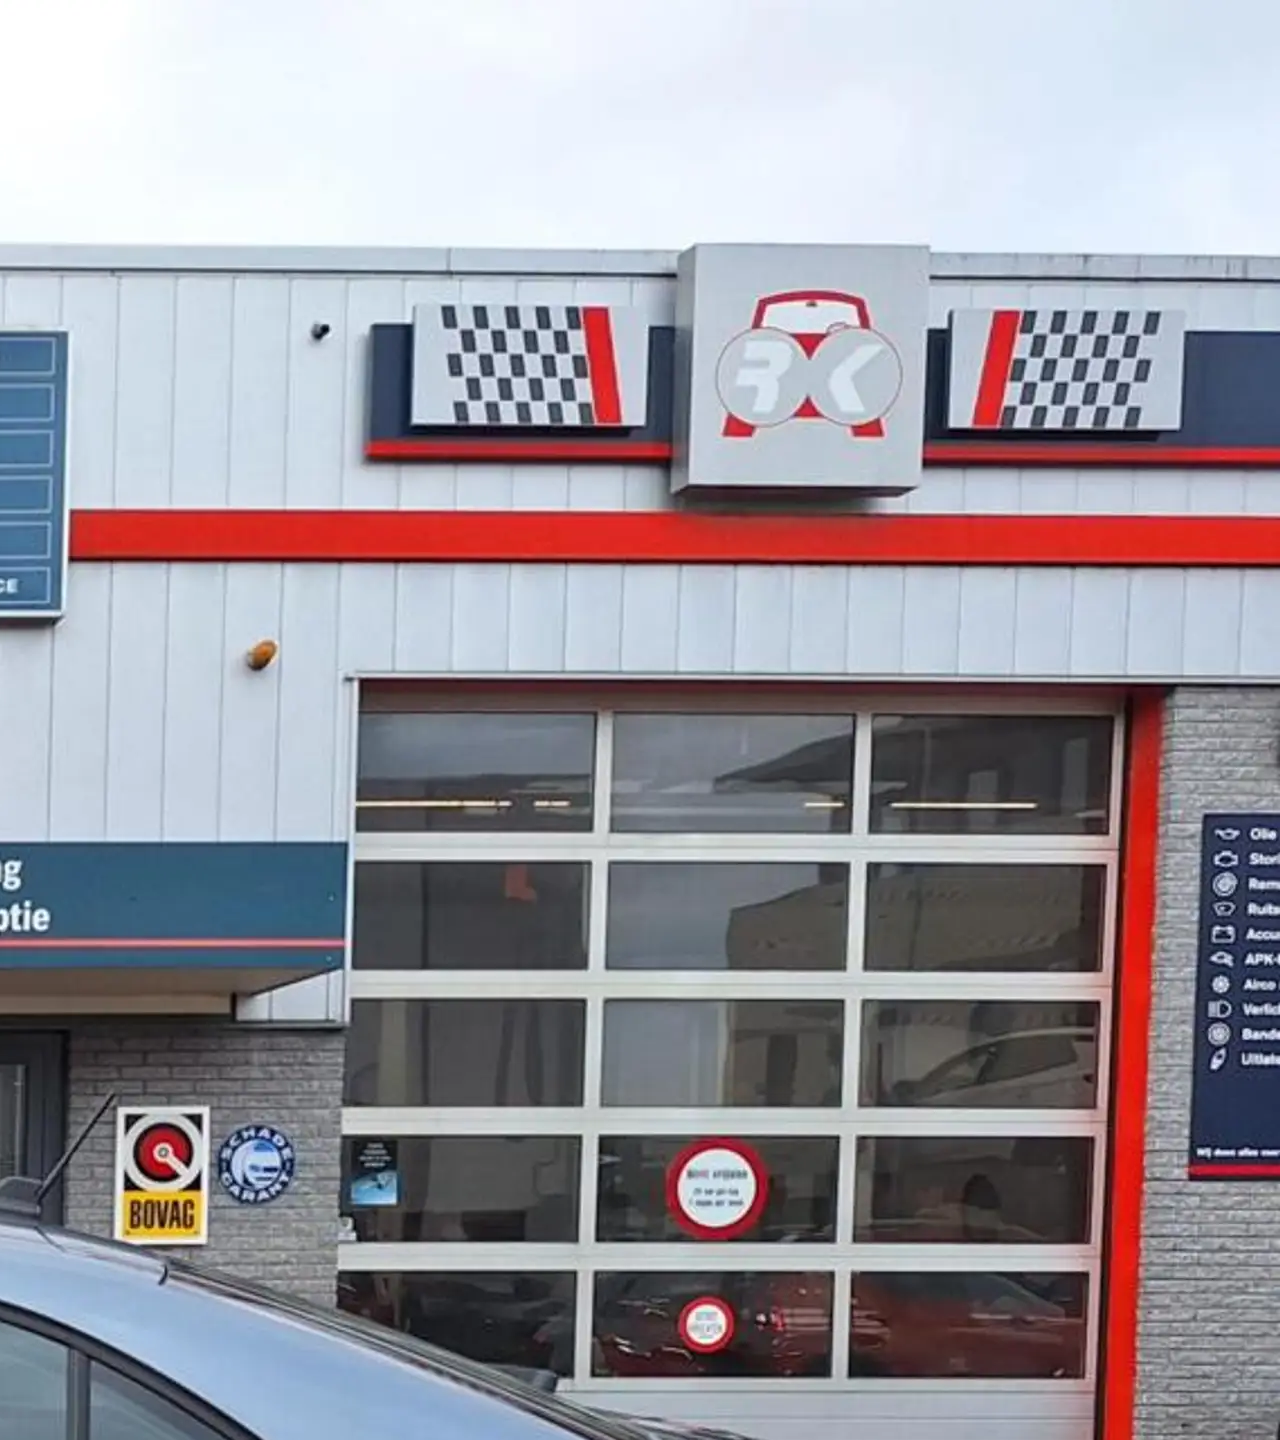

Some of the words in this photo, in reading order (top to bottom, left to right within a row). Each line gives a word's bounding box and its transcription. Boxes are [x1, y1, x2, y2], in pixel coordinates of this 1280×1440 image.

[1250, 827, 1277, 840] Olie
[1243, 978, 1277, 990] Airco
[129, 1199, 195, 1229] BOVAG
